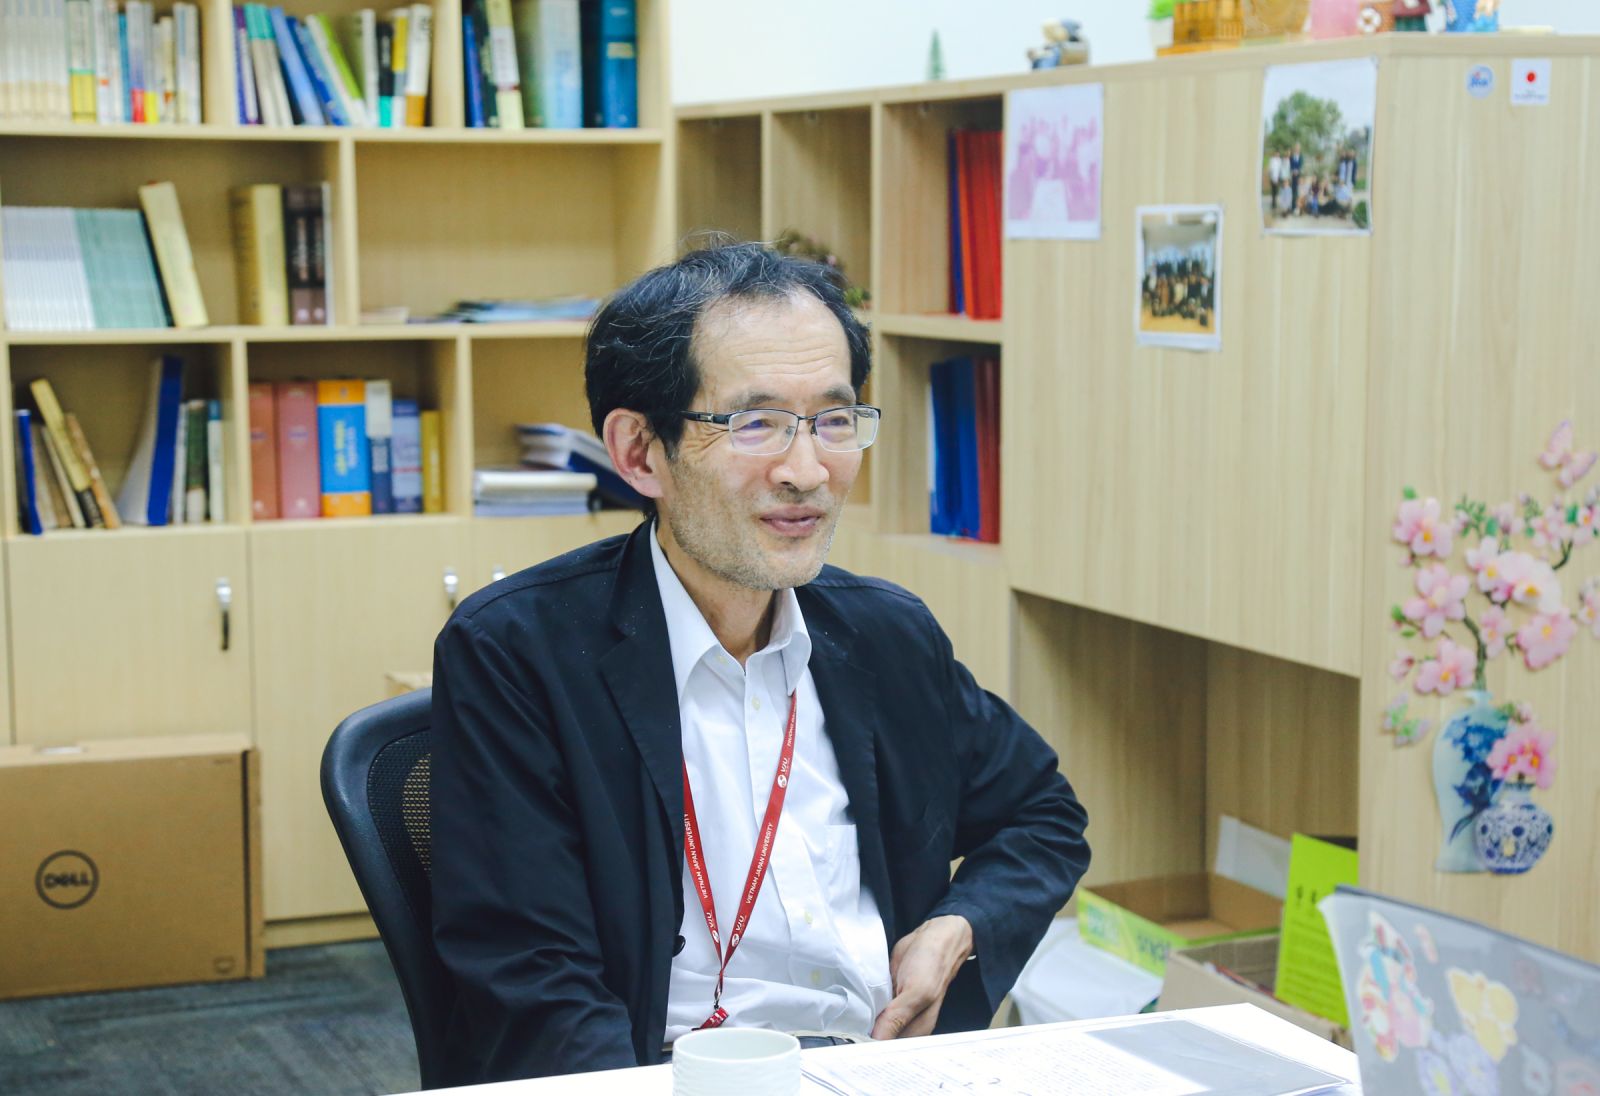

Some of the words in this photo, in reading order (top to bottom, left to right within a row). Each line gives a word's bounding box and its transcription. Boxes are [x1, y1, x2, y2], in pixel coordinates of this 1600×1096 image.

[691, 850, 701, 870] JAPAN
[44, 872, 89, 889] DELL
[696, 872, 708, 899] VIETNAM
[736, 915, 745, 931] VJU
[746, 877, 758, 904] VIETNAM
[755, 857, 765, 877] JAPAN
[761, 823, 774, 857] UNIVERSITY
[706, 912, 714, 928] VJU
